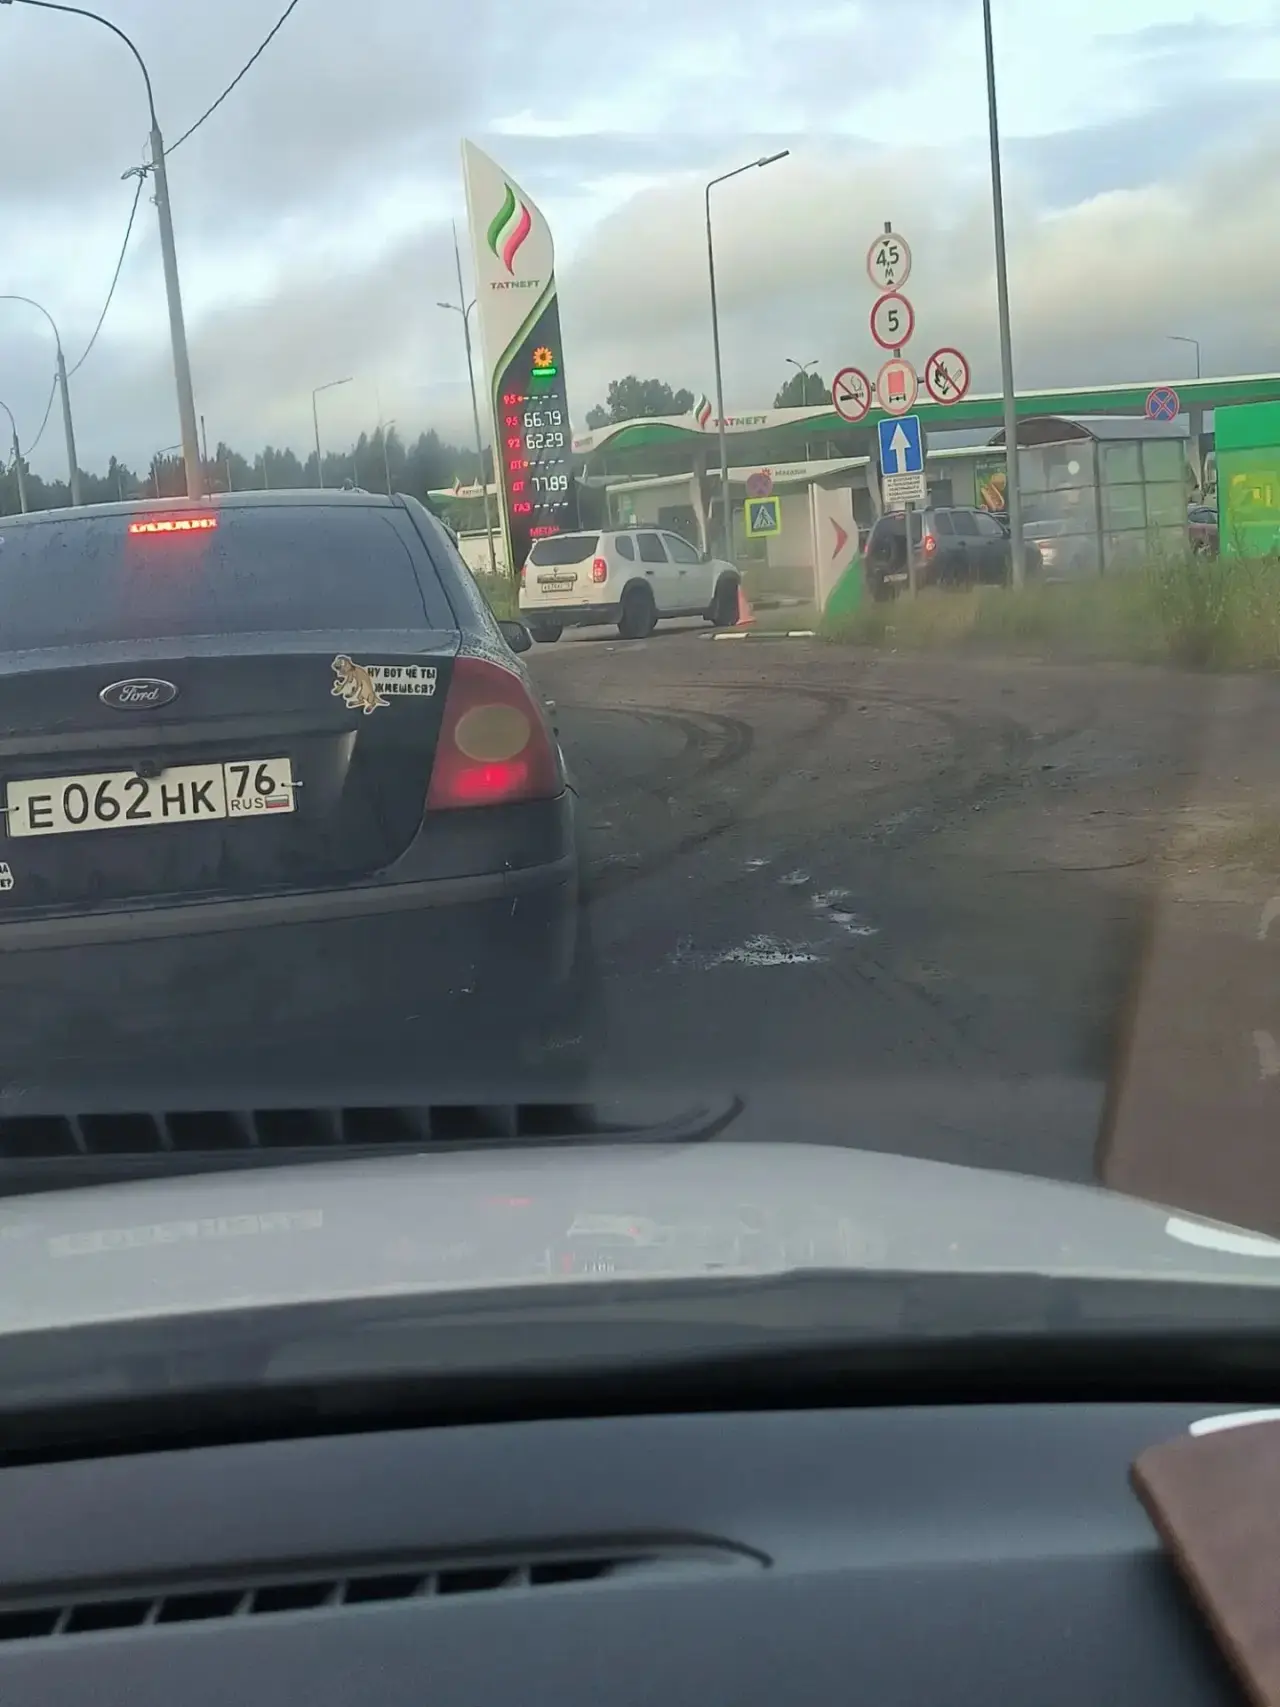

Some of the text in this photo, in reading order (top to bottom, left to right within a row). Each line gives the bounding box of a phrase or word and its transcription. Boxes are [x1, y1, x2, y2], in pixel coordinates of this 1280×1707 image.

[876, 246, 900, 268] 4,5
[490, 279, 540, 290] TATNEFT
[888, 309, 900, 332] 5
[523, 410, 562, 428] 66.79
[525, 432, 564, 450] 62.29
[531, 475, 568, 492] 77.89
[367, 667, 381, 678] НУ
[383, 667, 402, 678] ВОТ
[420, 668, 436, 679] ТЫ
[119, 684, 160, 702] Ford
[229, 763, 276, 798] 76
[231, 797, 264, 812] RUS
